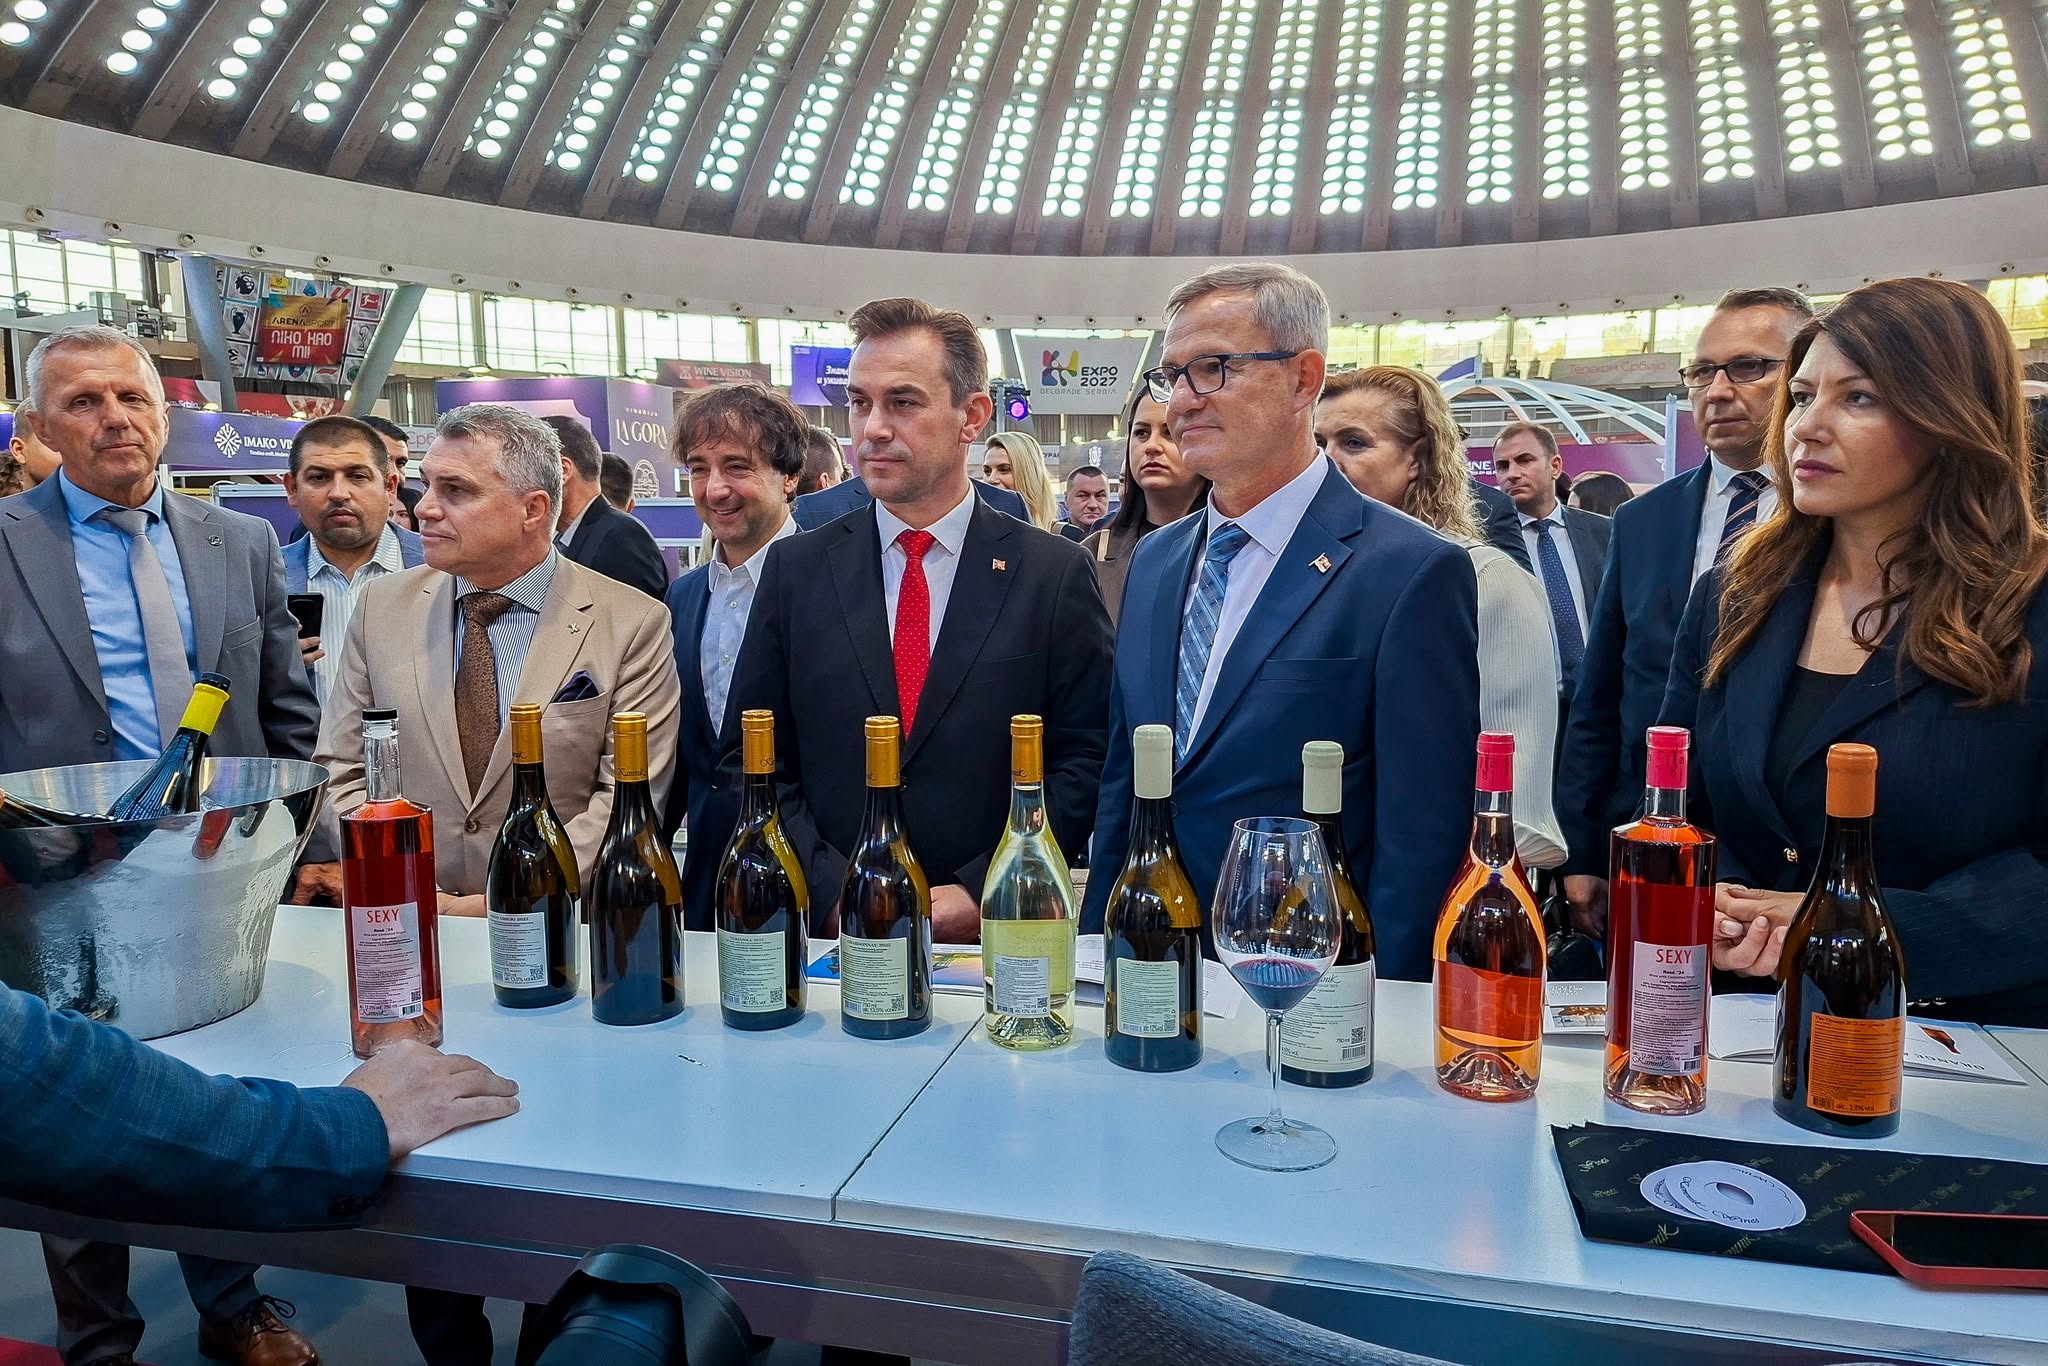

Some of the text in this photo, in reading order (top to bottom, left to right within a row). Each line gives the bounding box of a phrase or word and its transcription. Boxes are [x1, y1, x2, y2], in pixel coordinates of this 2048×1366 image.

[693, 365, 752, 378] WINE VISION
[1081, 366, 1118, 377] EXPO
[1080, 377, 1118, 387] 2027
[615, 418, 630, 446] LA
[243, 436, 278, 450] IMAKO
[366, 908, 400, 924] SEXY
[1655, 948, 1692, 964] SEXY
